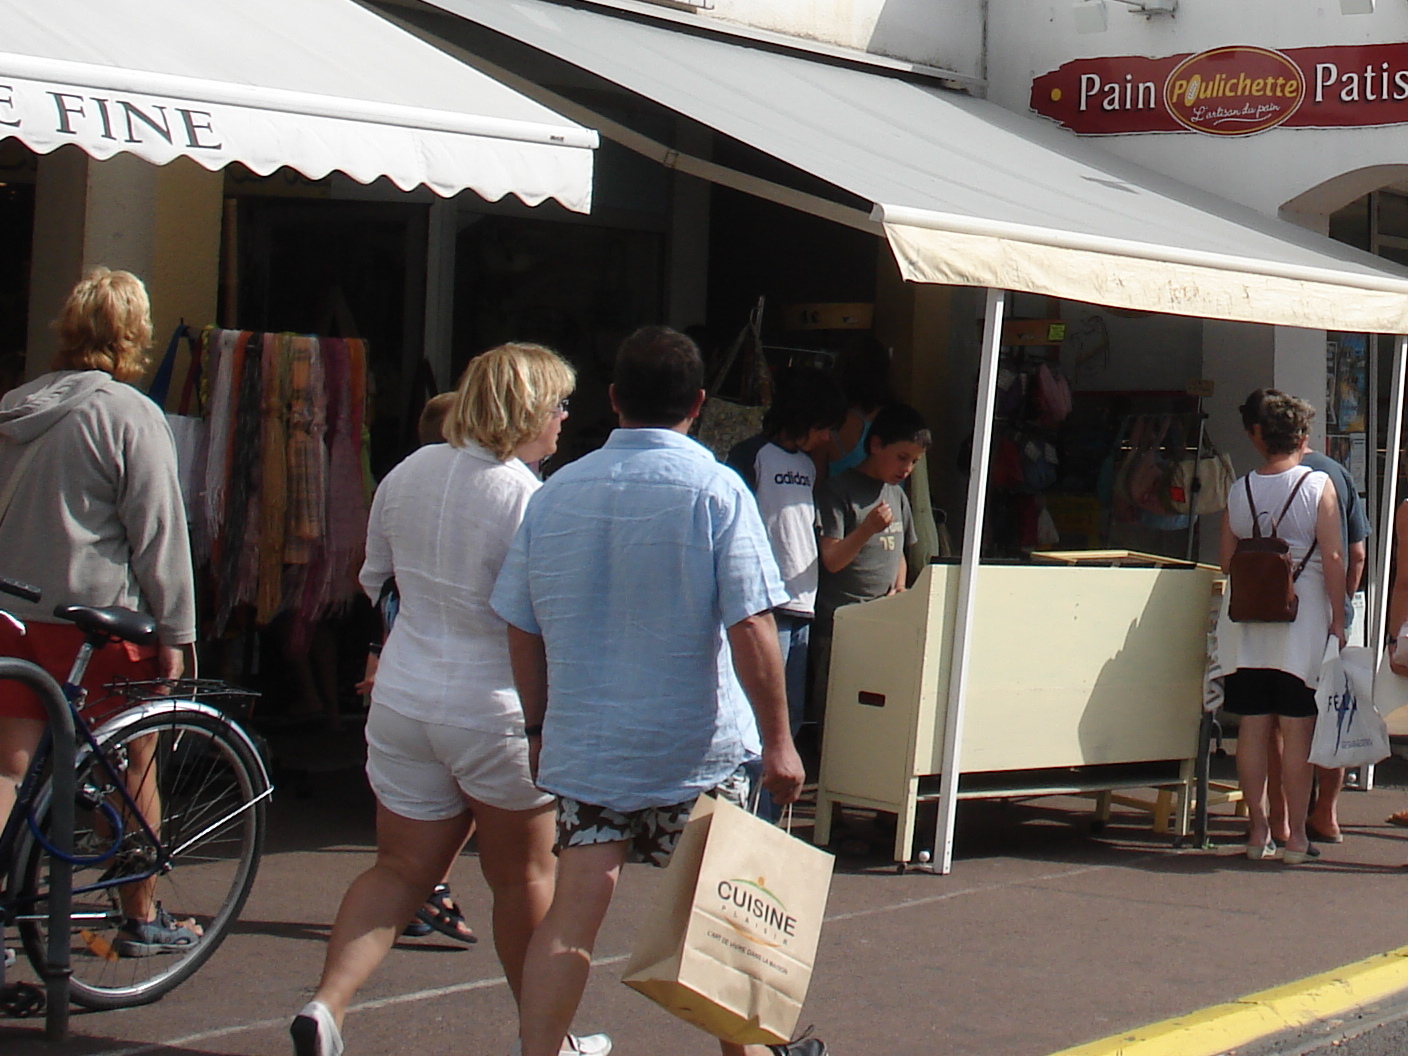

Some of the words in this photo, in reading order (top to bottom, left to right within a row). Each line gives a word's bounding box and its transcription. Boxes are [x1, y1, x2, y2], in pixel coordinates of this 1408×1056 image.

[1079, 73, 1156, 111] Pain
[1172, 72, 1298, 107] Poulichette
[45, 91, 222, 150] FINE
[774, 471, 810, 487] adidas
[717, 880, 798, 937] CUISINE
